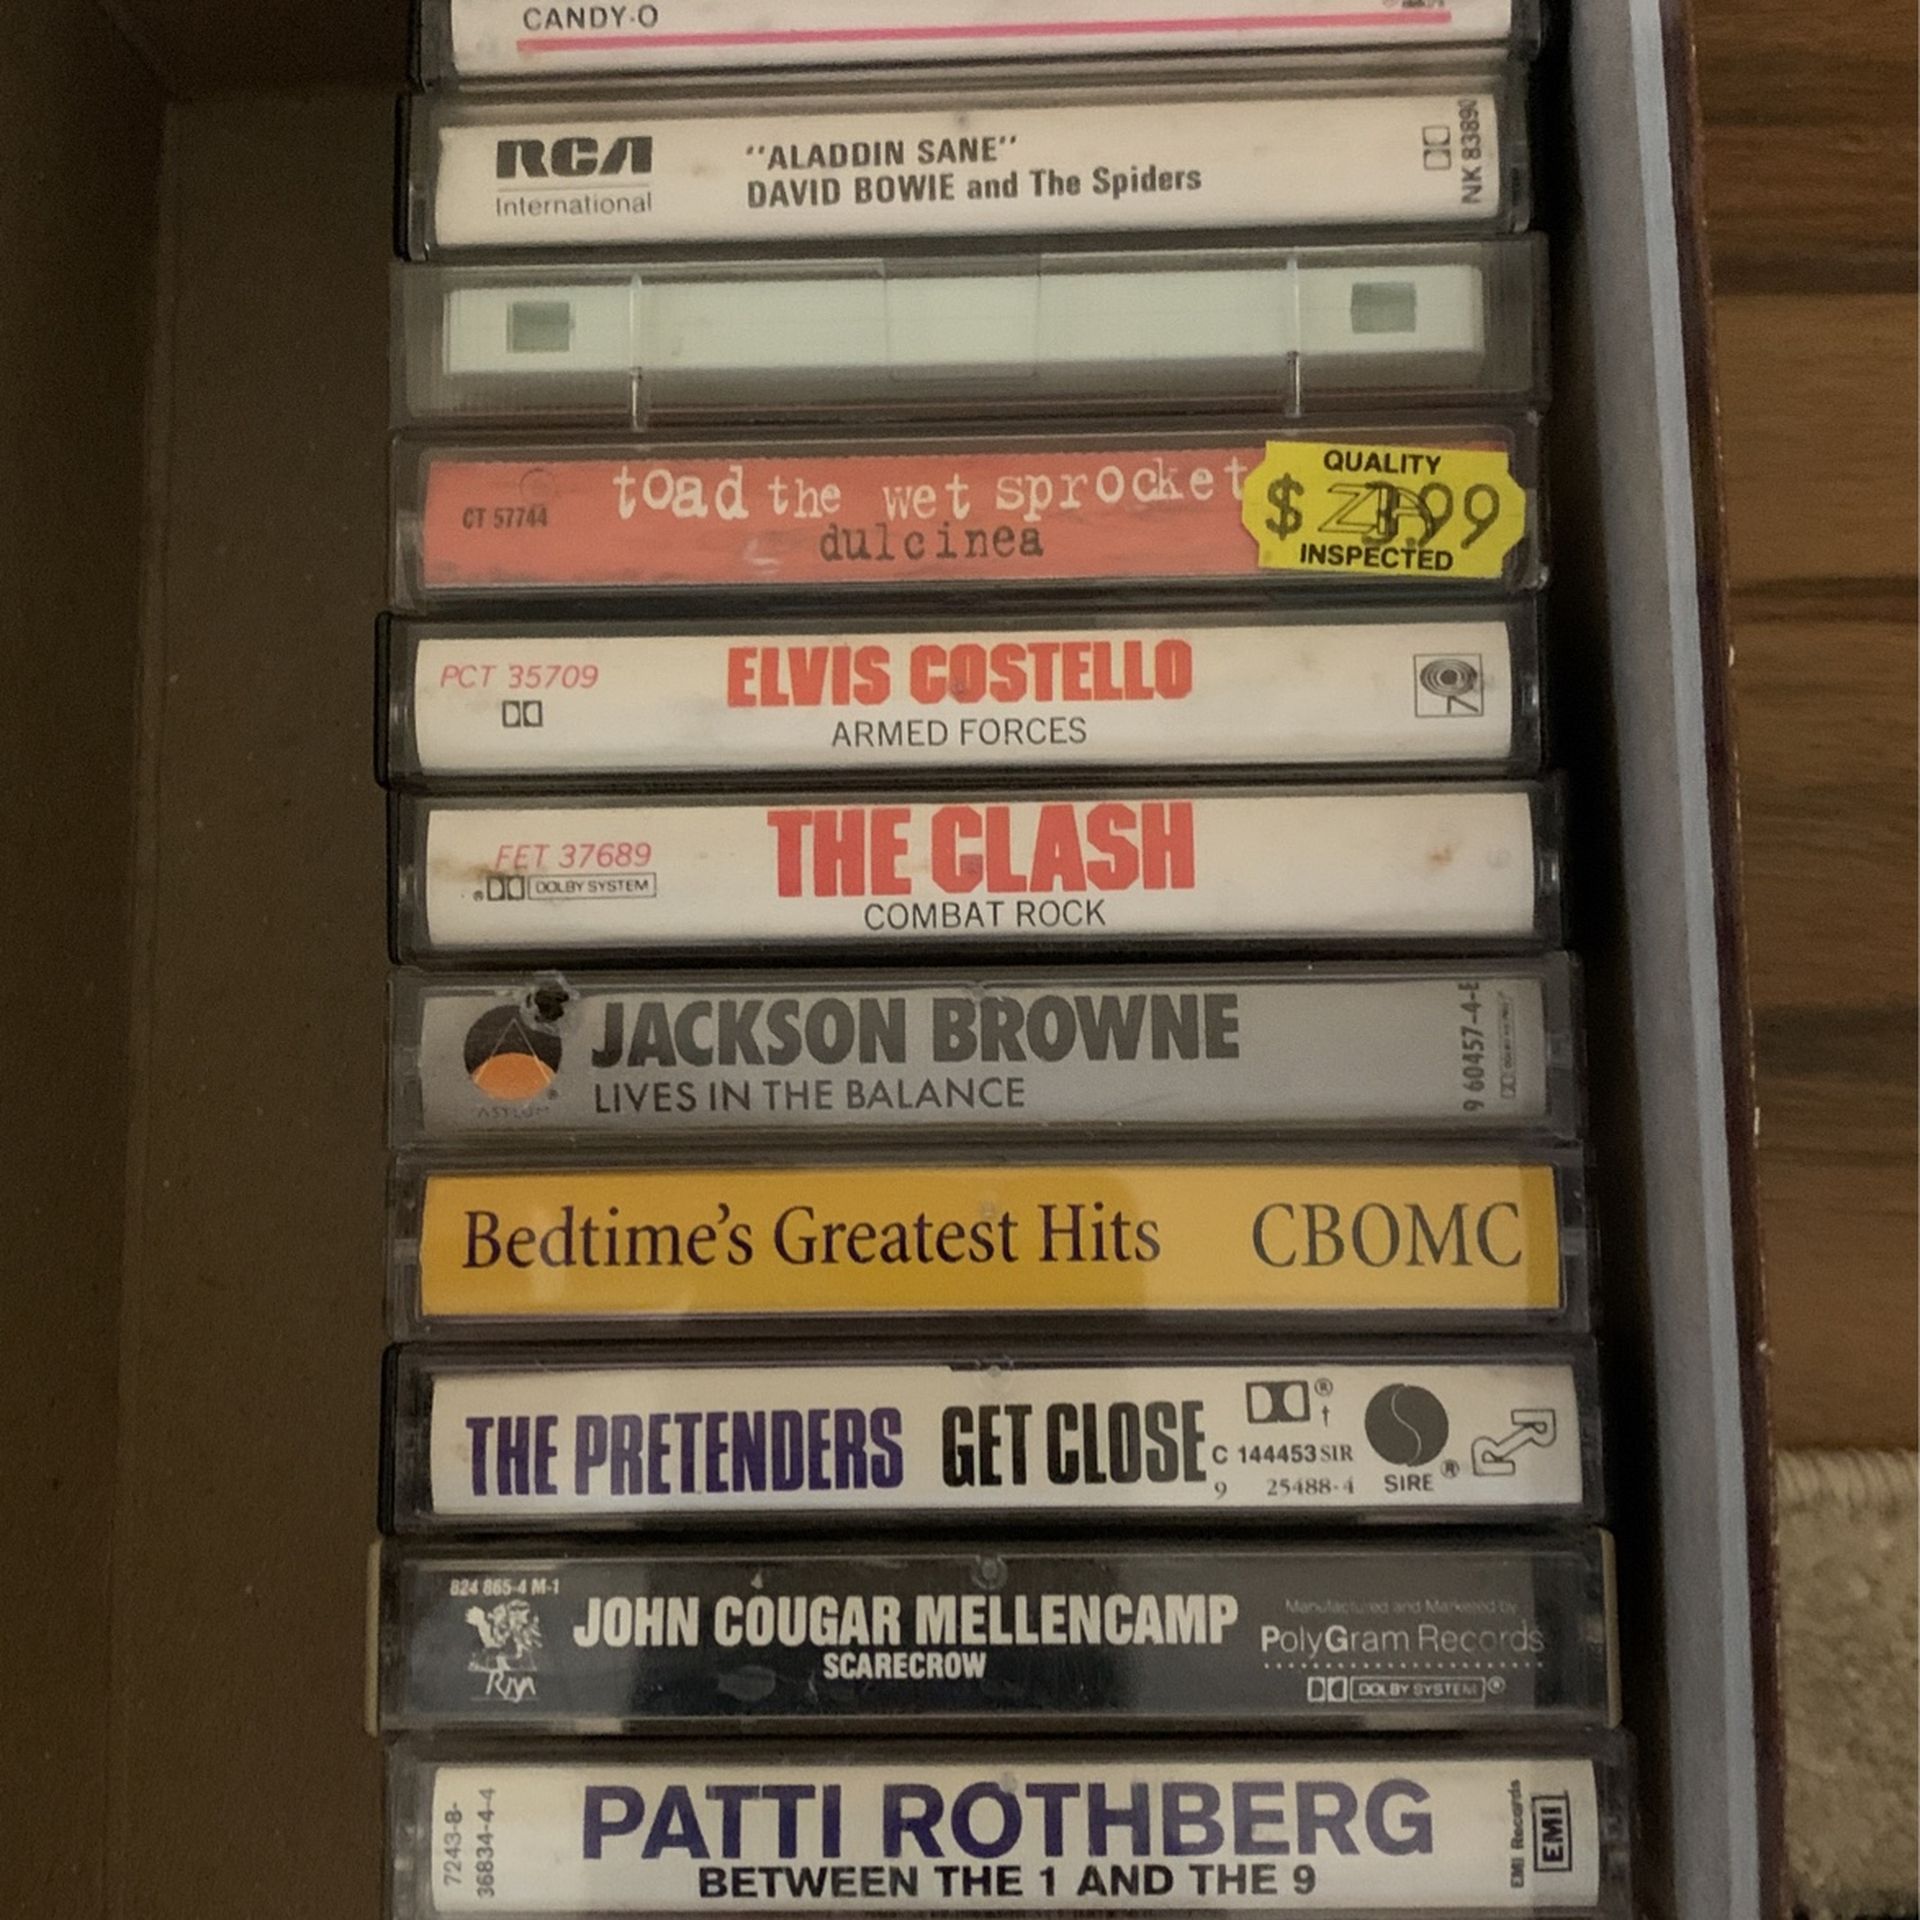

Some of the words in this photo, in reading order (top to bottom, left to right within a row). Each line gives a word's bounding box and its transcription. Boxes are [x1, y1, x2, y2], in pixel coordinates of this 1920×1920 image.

[496, 136, 653, 178] RCA
[747, 178, 840, 208] DAVID
[854, 173, 955, 204] BOWIE
[967, 171, 1018, 200] and
[1030, 168, 1081, 197] The
[1092, 165, 1202, 199] Spiders
[1461, 166, 1482, 204] NK
[496, 192, 653, 217] International
[1323, 449, 1441, 475] QUALITY
[613, 464, 750, 519] toad
[768, 474, 841, 518] the
[882, 473, 970, 520] wet
[994, 456, 1245, 521] sprocket
[462, 508, 486, 529] CT
[493, 507, 549, 529] 57744
[819, 522, 1044, 562] dulcinea
[1300, 543, 1454, 571] INSPECTED
[440, 664, 497, 689] PCT
[508, 663, 599, 689] 35709
[727, 645, 891, 708] ELVIS
[909, 639, 1193, 705] COSTELLO
[832, 719, 948, 747] ARMED
[960, 716, 1088, 746] FORCES
[495, 843, 550, 871] FET
[558, 842, 653, 868] 37689
[767, 807, 911, 898] THE
[931, 801, 1196, 894] CLASH
[535, 881, 584, 894] DOLBY
[588, 879, 650, 893] SYSTEM
[864, 900, 1005, 930] COMBAT
[1017, 898, 1106, 927] ROCK
[591, 997, 906, 1069] JACKSON
[932, 993, 1240, 1064] BROWNE
[594, 1081, 697, 1113] LIVES
[709, 1080, 750, 1112] IN
[762, 1079, 833, 1111] THE
[847, 1076, 1025, 1110] BALANCE
[1463, 1099, 1484, 1112] 9
[462, 1203, 754, 1269] Bedtime's
[774, 1204, 1018, 1266] Greatest
[1038, 1201, 1161, 1263] Hits
[1252, 1201, 1523, 1268] CBOMC
[466, 1416, 559, 1496] THE
[575, 1407, 904, 1496] PRETENDERS
[942, 1403, 1032, 1487] GET
[1047, 1400, 1207, 1486] CLOSE
[1211, 1447, 1229, 1465] C
[1213, 1480, 1228, 1500] 9
[1266, 1477, 1355, 1497] 25488-4
[1384, 1474, 1435, 1494] SIRE
[449, 1578, 479, 1597] 824
[482, 1578, 528, 1597] 865-4
[531, 1577, 560, 1596] M-1
[573, 1597, 699, 1649] JOHN
[714, 1595, 902, 1648] COUGAR
[916, 1593, 1239, 1647] MELLENCAMP
[1261, 1624, 1410, 1660] PolyGram
[1417, 1618, 1545, 1652] Records
[823, 1651, 987, 1680] SCARECROW
[1358, 1682, 1410, 1697] DOLBY
[1413, 1682, 1478, 1696] SYSTEM
[583, 1783, 841, 1860] PATTI
[883, 1778, 1433, 1860] ROTHBERG
[1506, 1778, 1525, 1850] Records
[475, 1787, 496, 1899] 36834-4-4
[1540, 1806, 1564, 1863] EMI
[700, 1866, 919, 1898] BETWEEN
[935, 1865, 1023, 1897] THE
[1039, 1866, 1056, 1896] 1
[1076, 1865, 1174, 1896] AND
[1189, 1864, 1278, 1896] THE
[1293, 1863, 1317, 1895] 9
[1510, 1857, 1525, 1889] EMI
